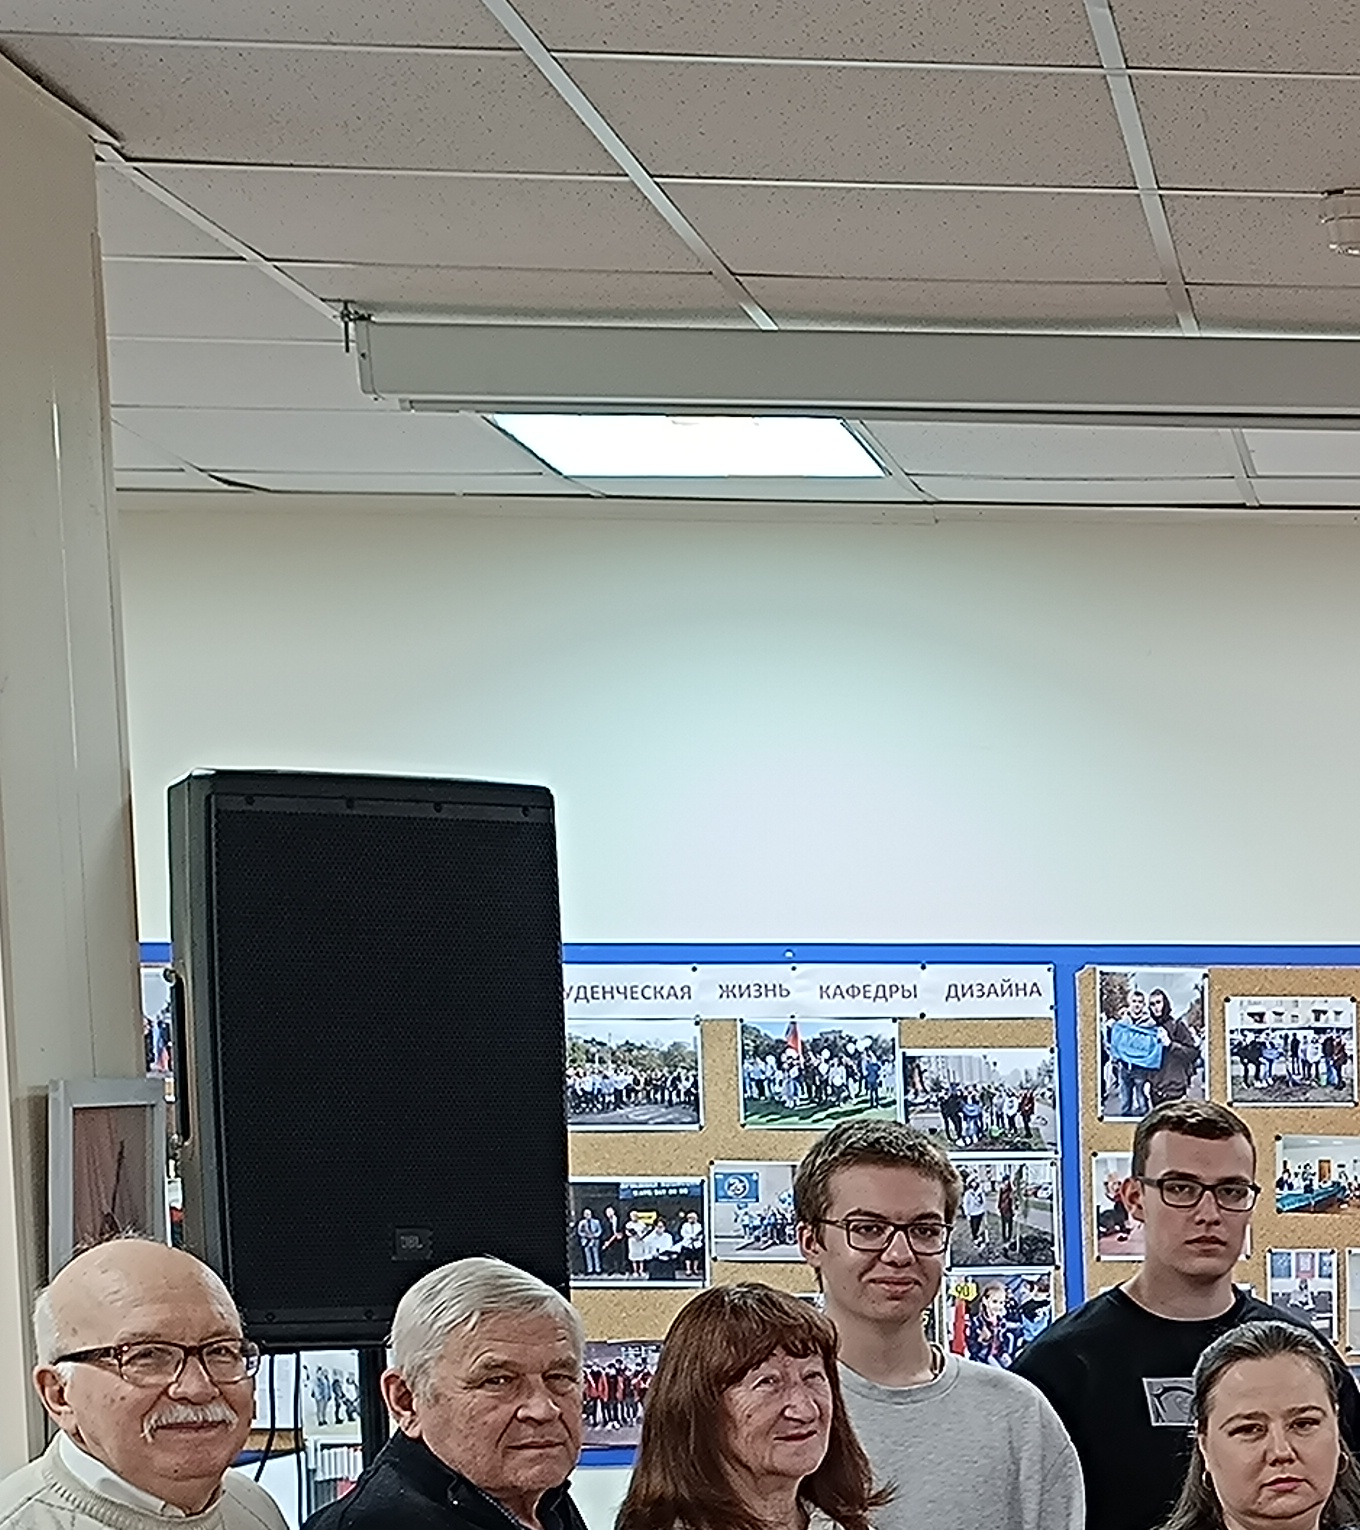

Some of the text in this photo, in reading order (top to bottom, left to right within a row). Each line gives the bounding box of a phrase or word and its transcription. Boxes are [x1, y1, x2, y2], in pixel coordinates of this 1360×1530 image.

[564, 979, 1043, 1003] УДЕНЧЕСКАЯ ЖИЗНЬ КАФЕДРЫ ДИЗАЙНА
